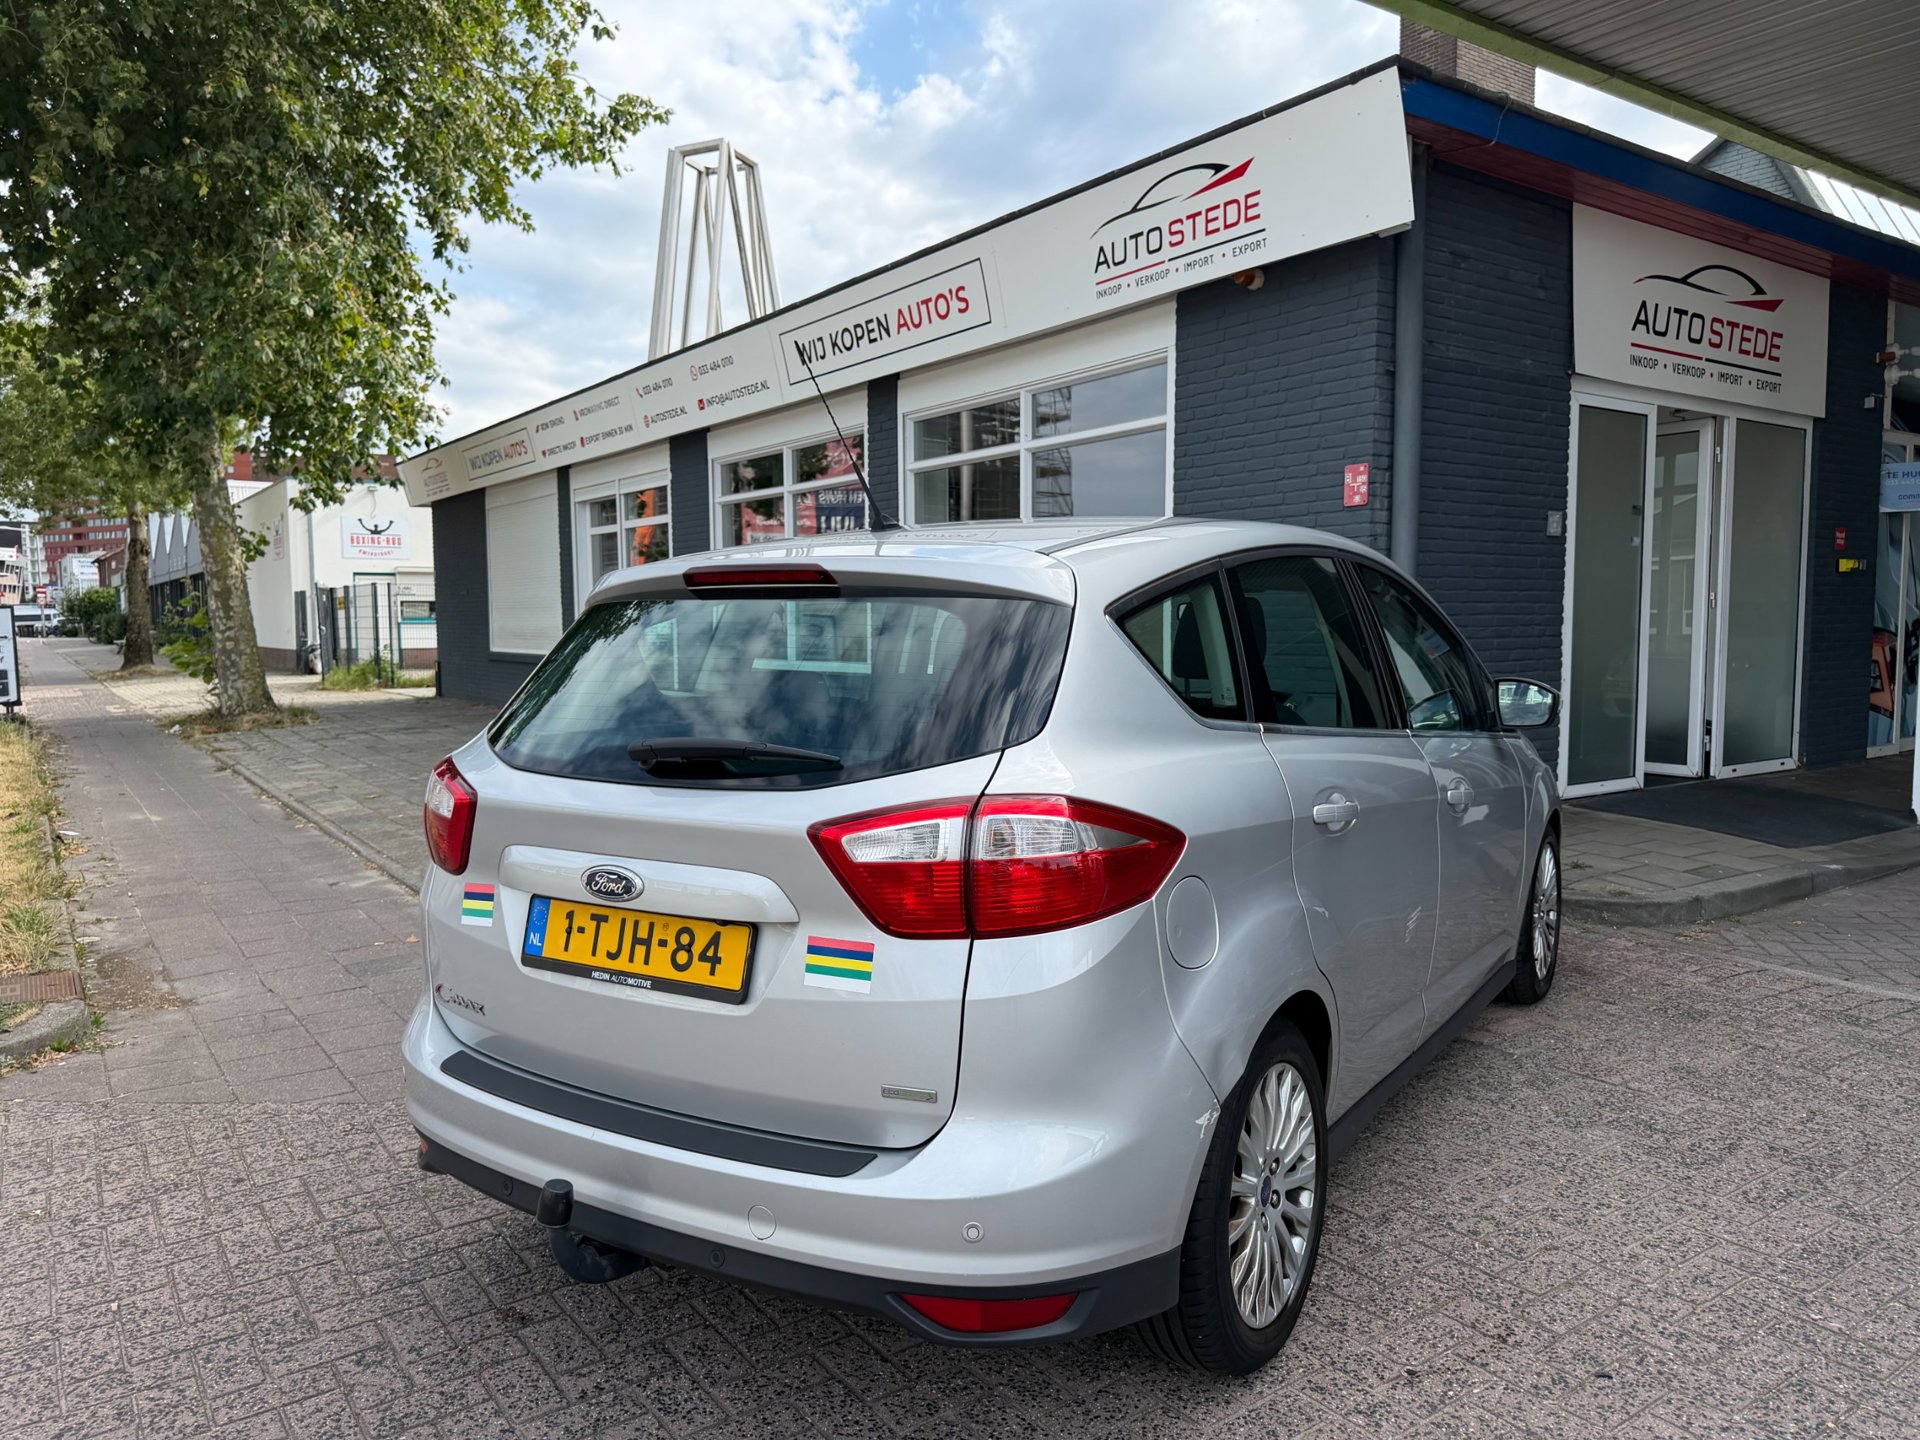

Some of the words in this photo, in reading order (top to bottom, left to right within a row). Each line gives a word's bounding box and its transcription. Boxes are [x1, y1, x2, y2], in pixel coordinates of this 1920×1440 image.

[1096, 283, 1123, 299] INKOOP
[1134, 269, 1170, 287] VERKOOP
[1183, 254, 1214, 272] IMPORT
[1232, 238, 1268, 257] EXPORT
[798, 336, 826, 366] WIJ
[829, 314, 891, 356] KOPEN
[897, 285, 970, 335] AUTO'S
[698, 364, 709, 376] 033
[709, 360, 722, 371] 484
[1629, 354, 1659, 370] INKOOP
[1672, 362, 1706, 379] VERKOOP
[1717, 371, 1744, 387] IMPORT
[1756, 379, 1782, 394] EXPORT
[705, 379, 770, 407] INFO@AUTOSTEDE.NL
[650, 405, 688, 424] AUTOSTEDE.NL
[481, 449, 504, 467] KOPEN
[503, 440, 528, 461] AUTO'S
[1886, 471, 1899, 479] TE
[590, 872, 626, 895] Ford
[528, 932, 542, 947] NL
[563, 910, 723, 977] 1-TJH-84
[591, 971, 610, 980] HEDIN
[611, 975, 652, 988] AUTOMOTIVE
